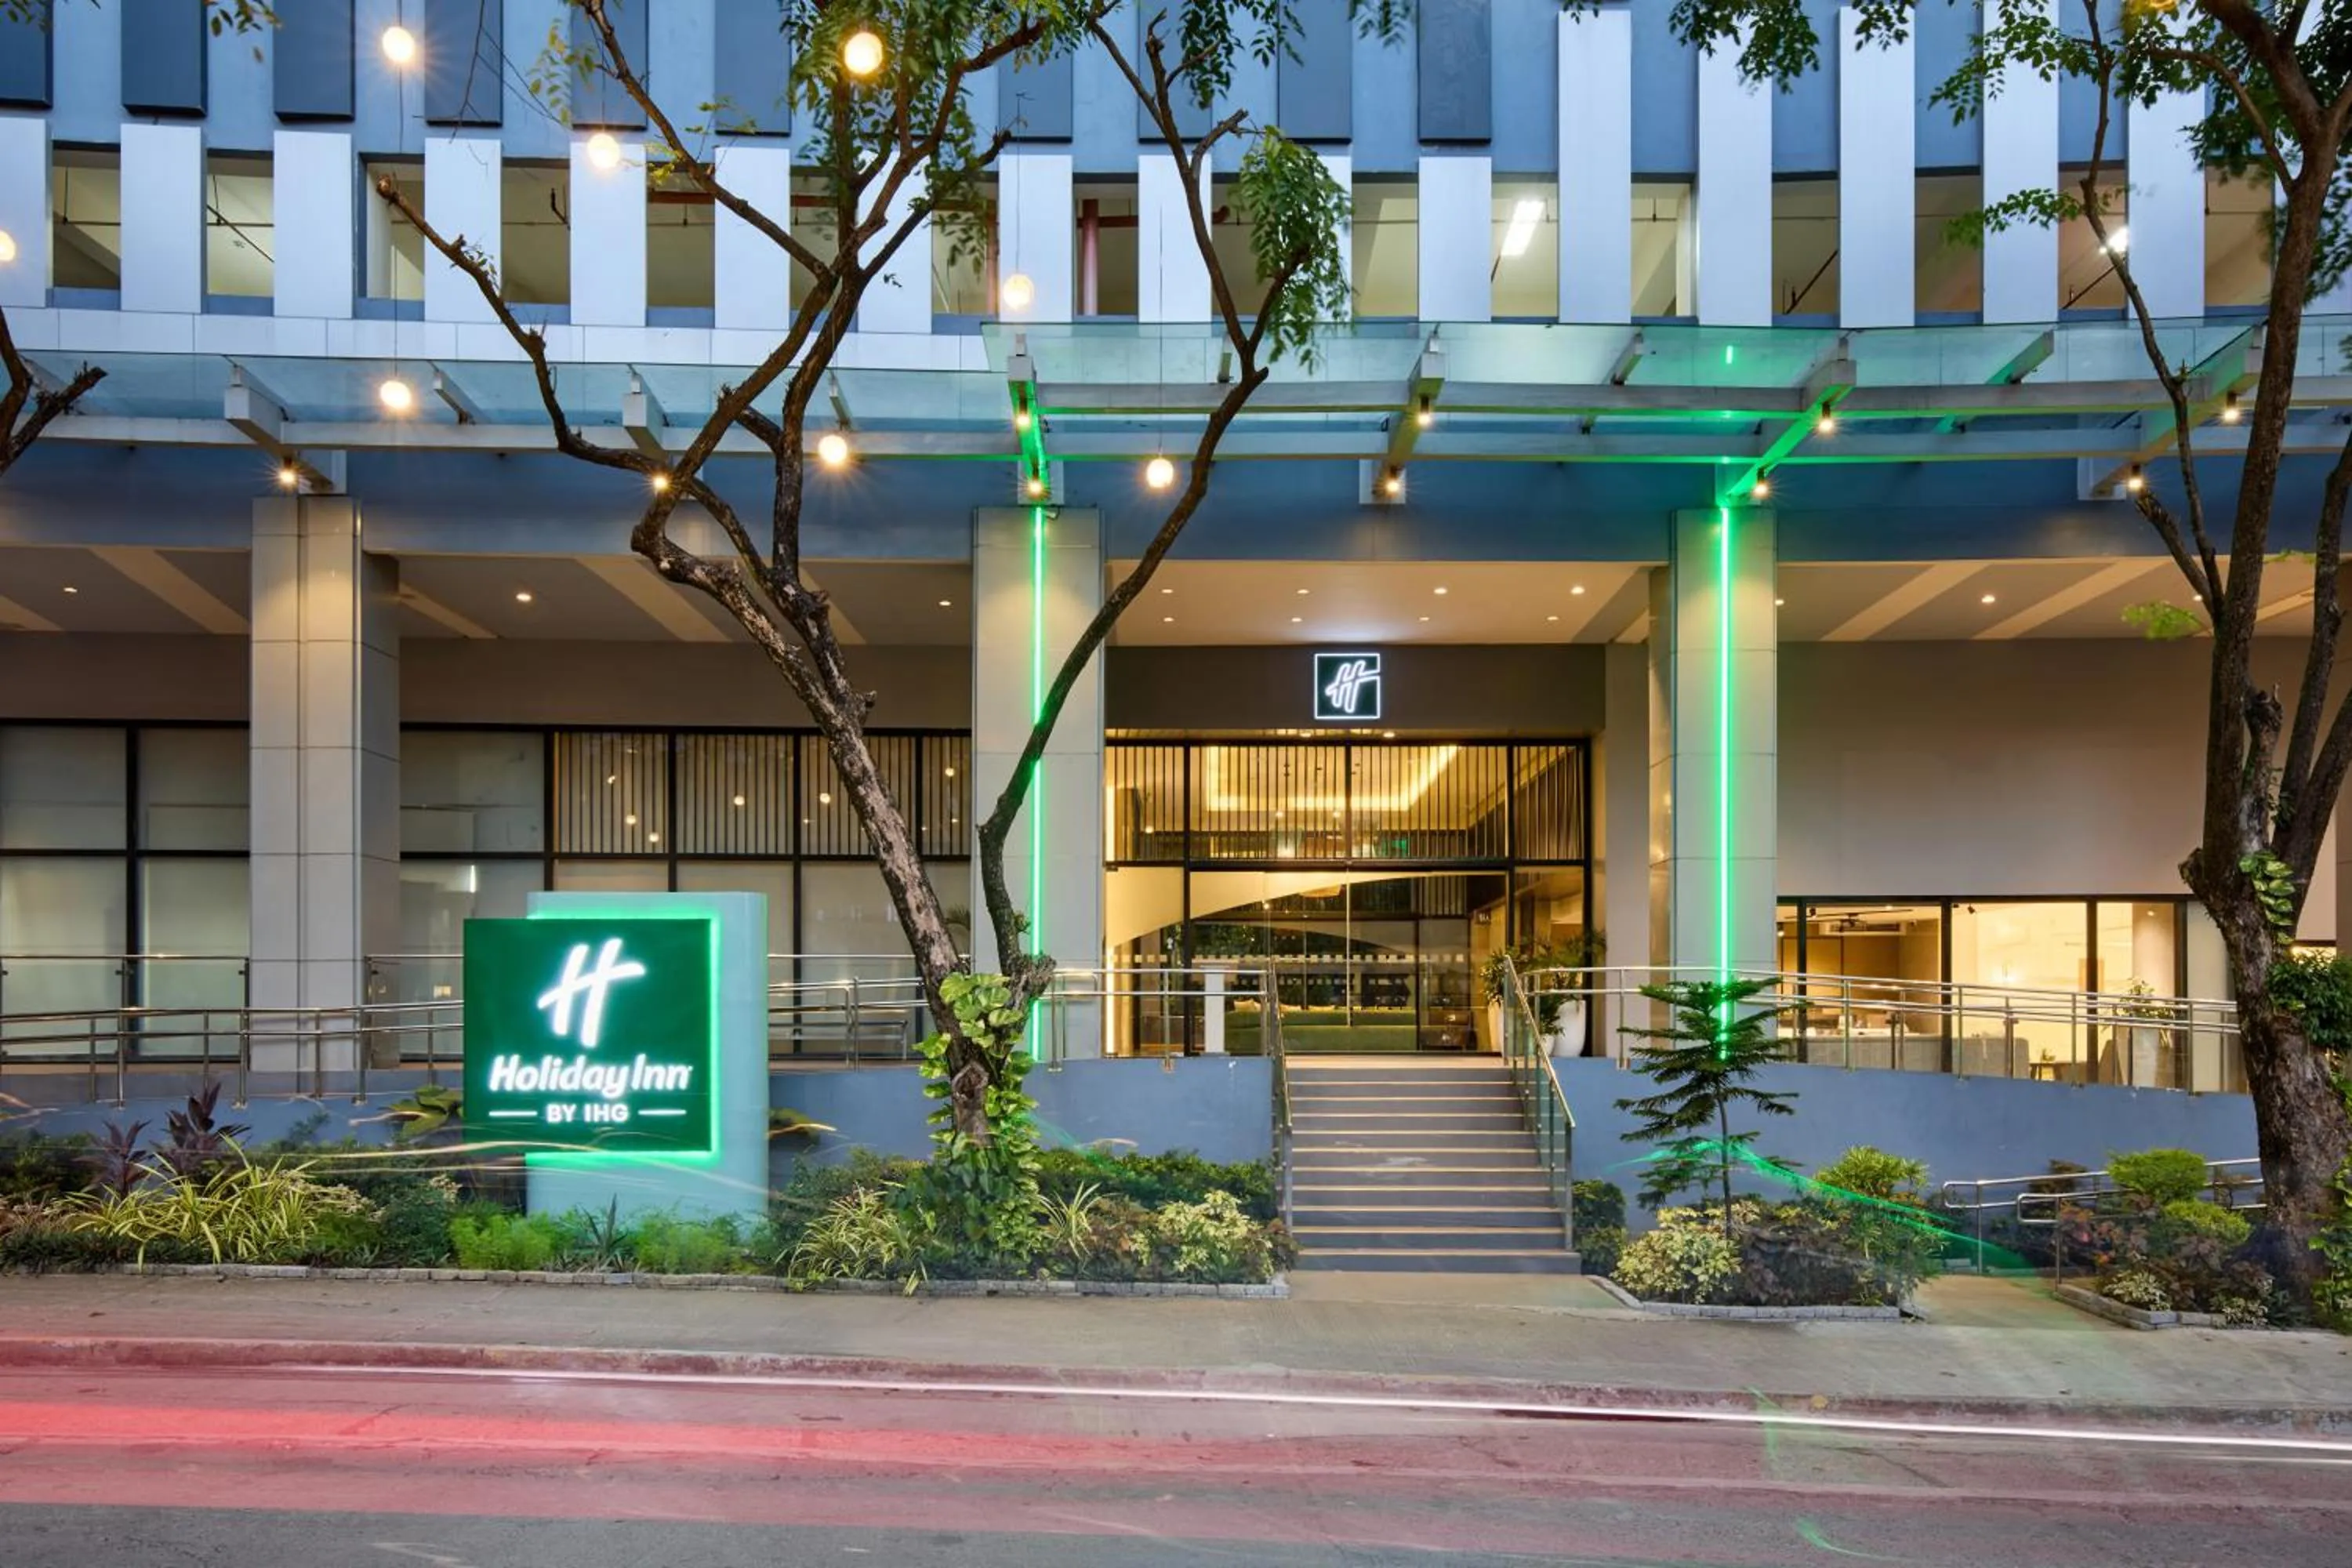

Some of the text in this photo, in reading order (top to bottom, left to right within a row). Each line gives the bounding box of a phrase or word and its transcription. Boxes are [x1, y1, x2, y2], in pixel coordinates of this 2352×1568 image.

[537, 938, 646, 1048] H
[488, 1054, 691, 1099] Holiday Inn
[546, 1103, 629, 1123] BY IHG
